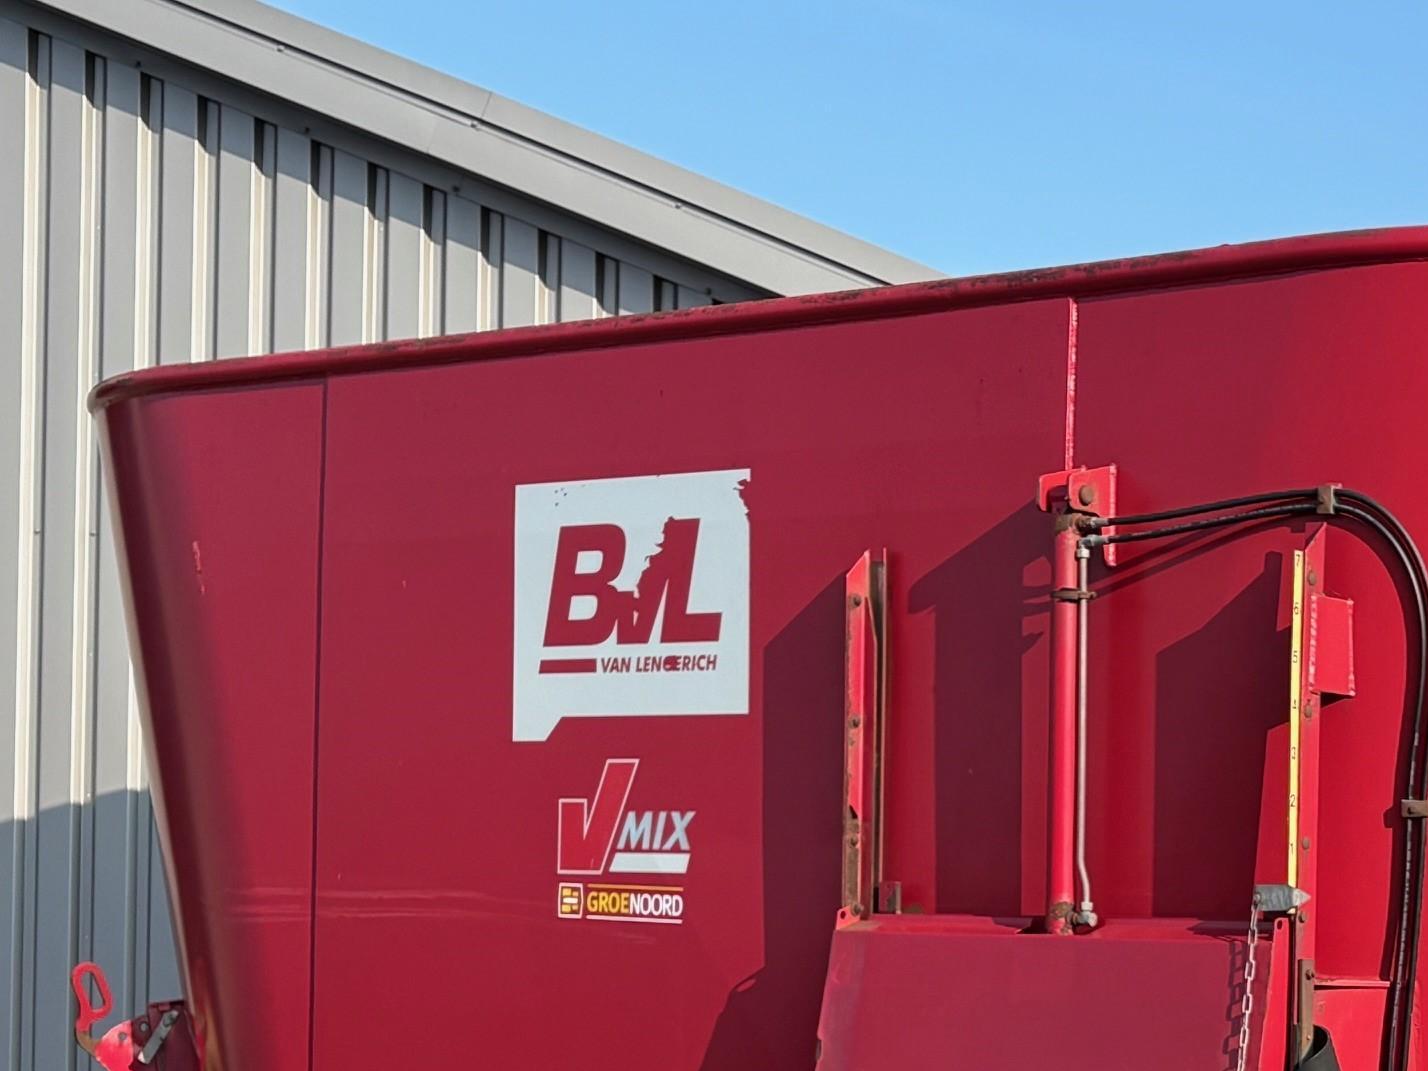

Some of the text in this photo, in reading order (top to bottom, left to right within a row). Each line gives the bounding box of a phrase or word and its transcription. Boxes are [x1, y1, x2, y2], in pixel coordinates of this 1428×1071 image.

[601, 656, 631, 673] VAN
[617, 810, 697, 851] MIX
[586, 891, 684, 917] GROENOORD
